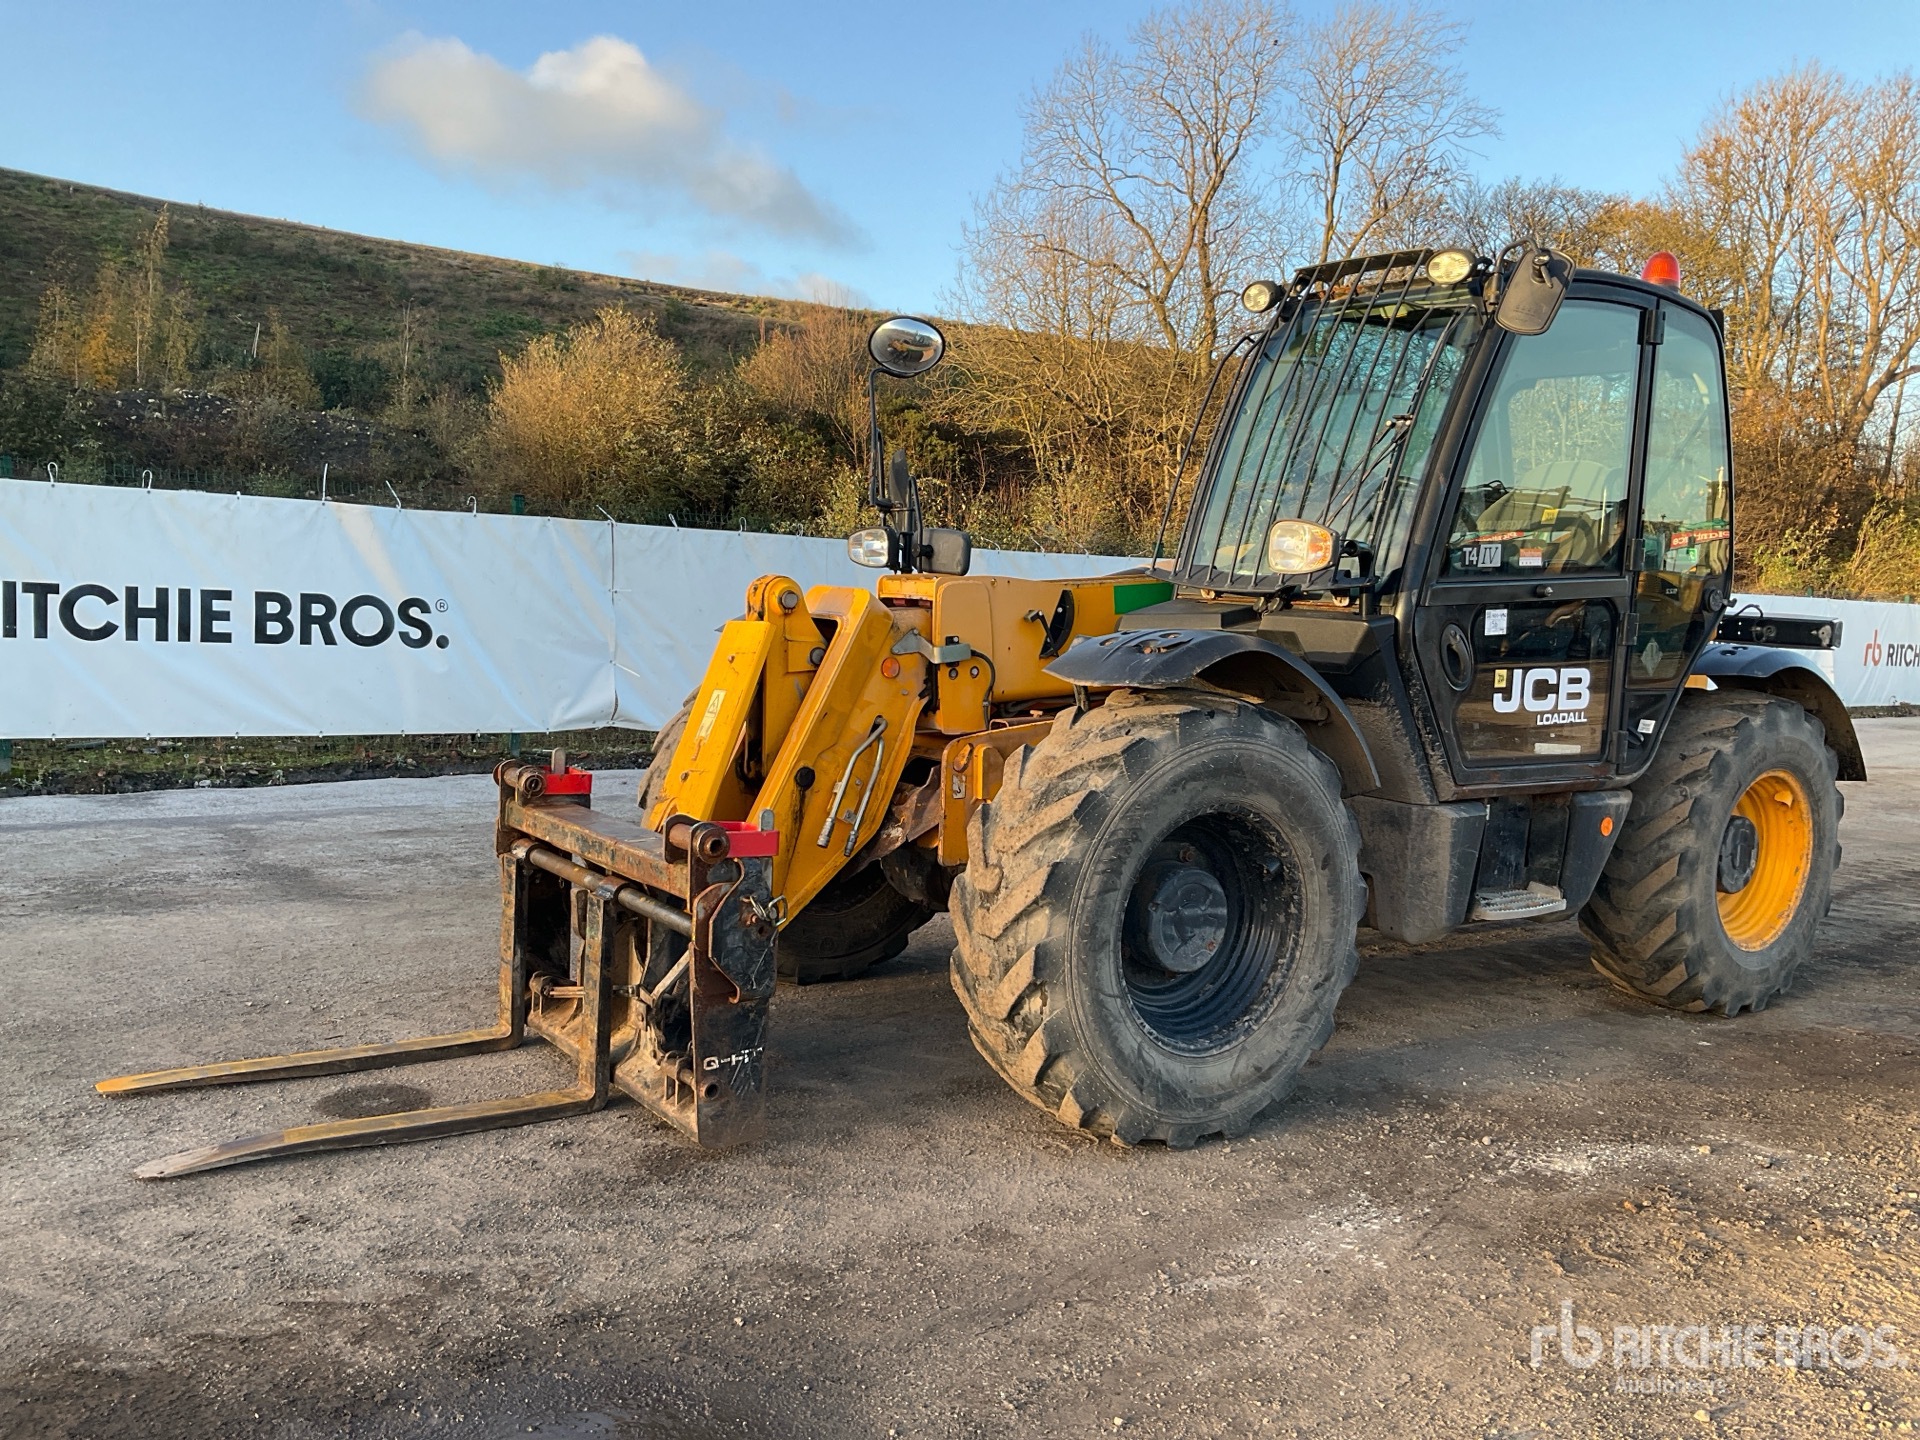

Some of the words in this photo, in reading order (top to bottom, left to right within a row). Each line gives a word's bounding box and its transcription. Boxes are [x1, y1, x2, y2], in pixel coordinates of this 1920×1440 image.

[1463, 547, 1478, 565] T4
[1481, 546, 1499, 565] IV
[1863, 629, 1882, 666] rb
[1493, 668, 1590, 713] JCB
[1537, 711, 1587, 725] LOADALL
